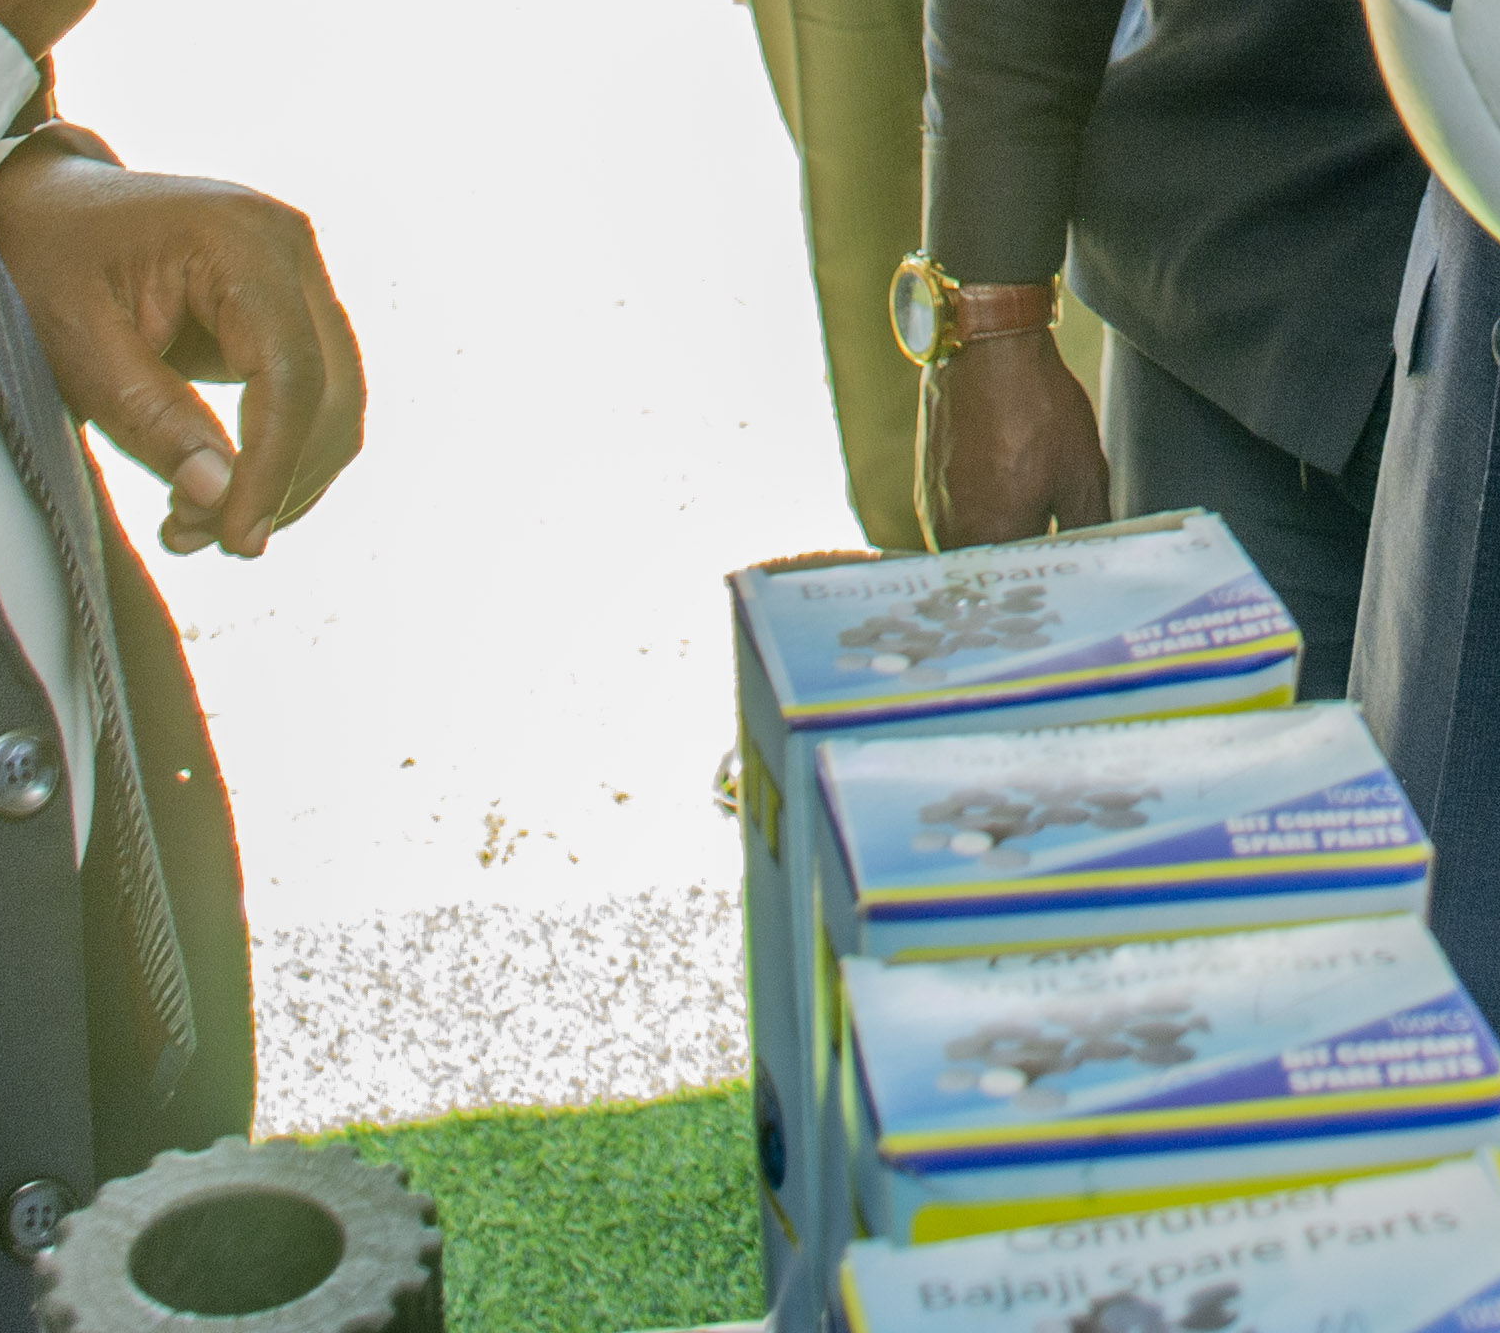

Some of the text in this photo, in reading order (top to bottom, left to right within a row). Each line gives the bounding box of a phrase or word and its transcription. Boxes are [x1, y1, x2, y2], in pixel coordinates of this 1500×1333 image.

[801, 573, 930, 602] Bajaji
[943, 557, 1081, 589] Spare
[1232, 826, 1409, 855] SPARE PARTS
[1288, 1053, 1484, 1093] SPARE PARTS
[918, 1208, 1460, 1311] Bajaji Spare Parts
